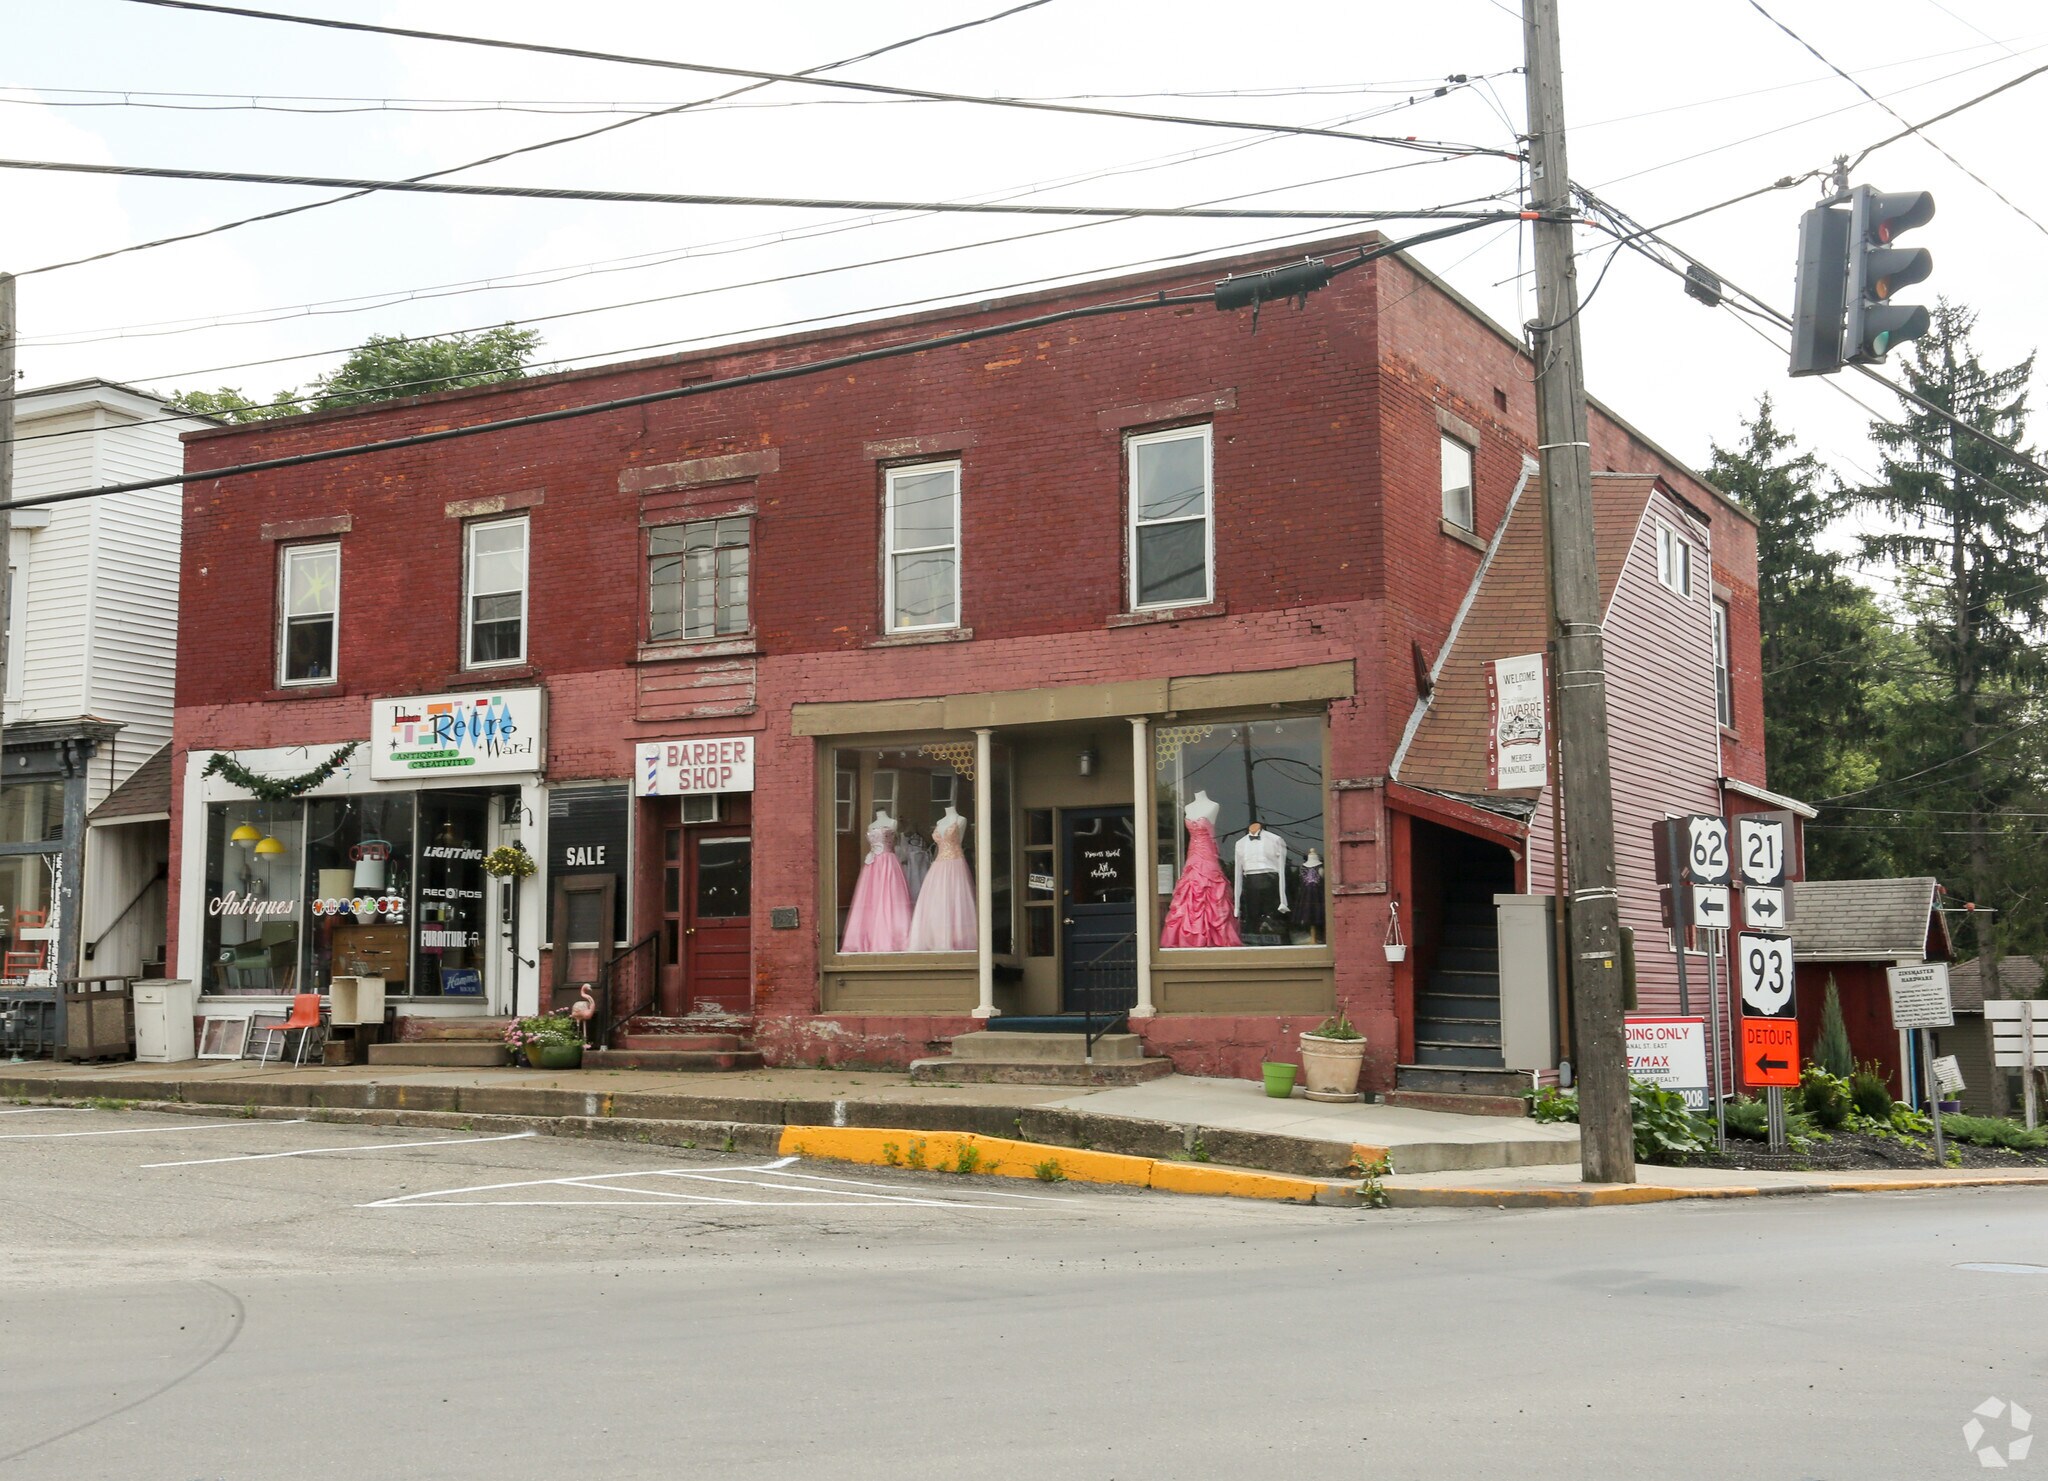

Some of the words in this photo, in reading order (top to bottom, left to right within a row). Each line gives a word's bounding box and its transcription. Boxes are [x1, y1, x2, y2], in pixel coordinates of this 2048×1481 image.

[1503, 671, 1536, 684] WELCOME
[1500, 702, 1542, 720] NAVARRE
[428, 711, 517, 744] Retro
[396, 750, 445, 760] ANTIQUES
[486, 737, 532, 758] Ward
[666, 741, 746, 767] BARBER
[411, 758, 470, 769] CREATIVITY
[1511, 753, 1532, 763] MERCER
[679, 766, 732, 790] SHOP
[1498, 766, 1527, 775] FINANCIAL
[1529, 763, 1546, 773] GROUP
[349, 844, 389, 863] OPEN
[566, 846, 606, 866] SALE
[1694, 830, 1723, 867] 62
[1748, 833, 1774, 869] 21
[423, 888, 483, 899] RECORDS
[209, 890, 294, 923] Antiques
[313, 897, 401, 915] VINTAGE
[420, 930, 467, 948] FURNITURE
[1750, 948, 1784, 994] 93
[1625, 1028, 1654, 1041] DING
[1656, 1028, 1690, 1040] ONLY
[1748, 1029, 1793, 1046] DETOUR
[1626, 1056, 1670, 1068] E/MAX
